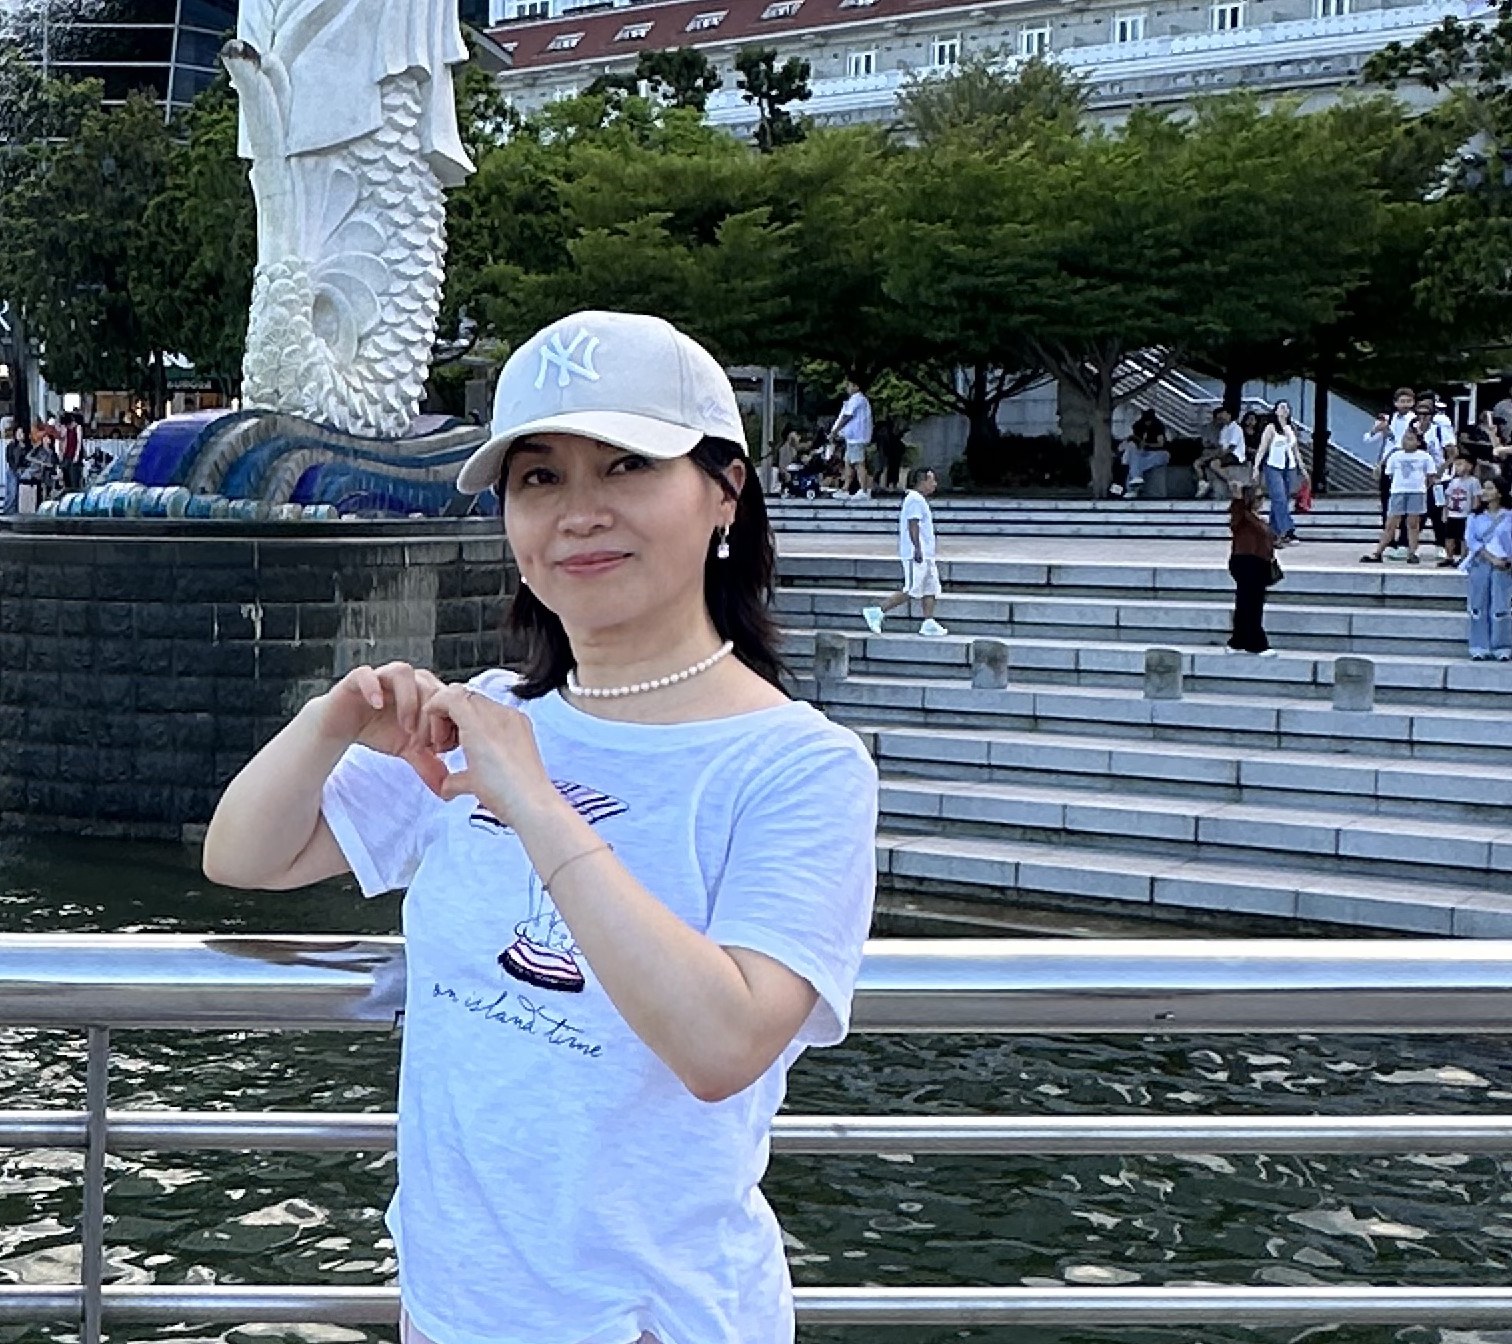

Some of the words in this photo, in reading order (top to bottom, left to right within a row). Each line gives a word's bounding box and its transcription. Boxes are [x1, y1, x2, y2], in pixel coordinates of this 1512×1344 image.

[534, 327, 601, 390] NY
[432, 982, 459, 1003] on
[464, 990, 536, 1035] island
[539, 1005, 603, 1058] time
